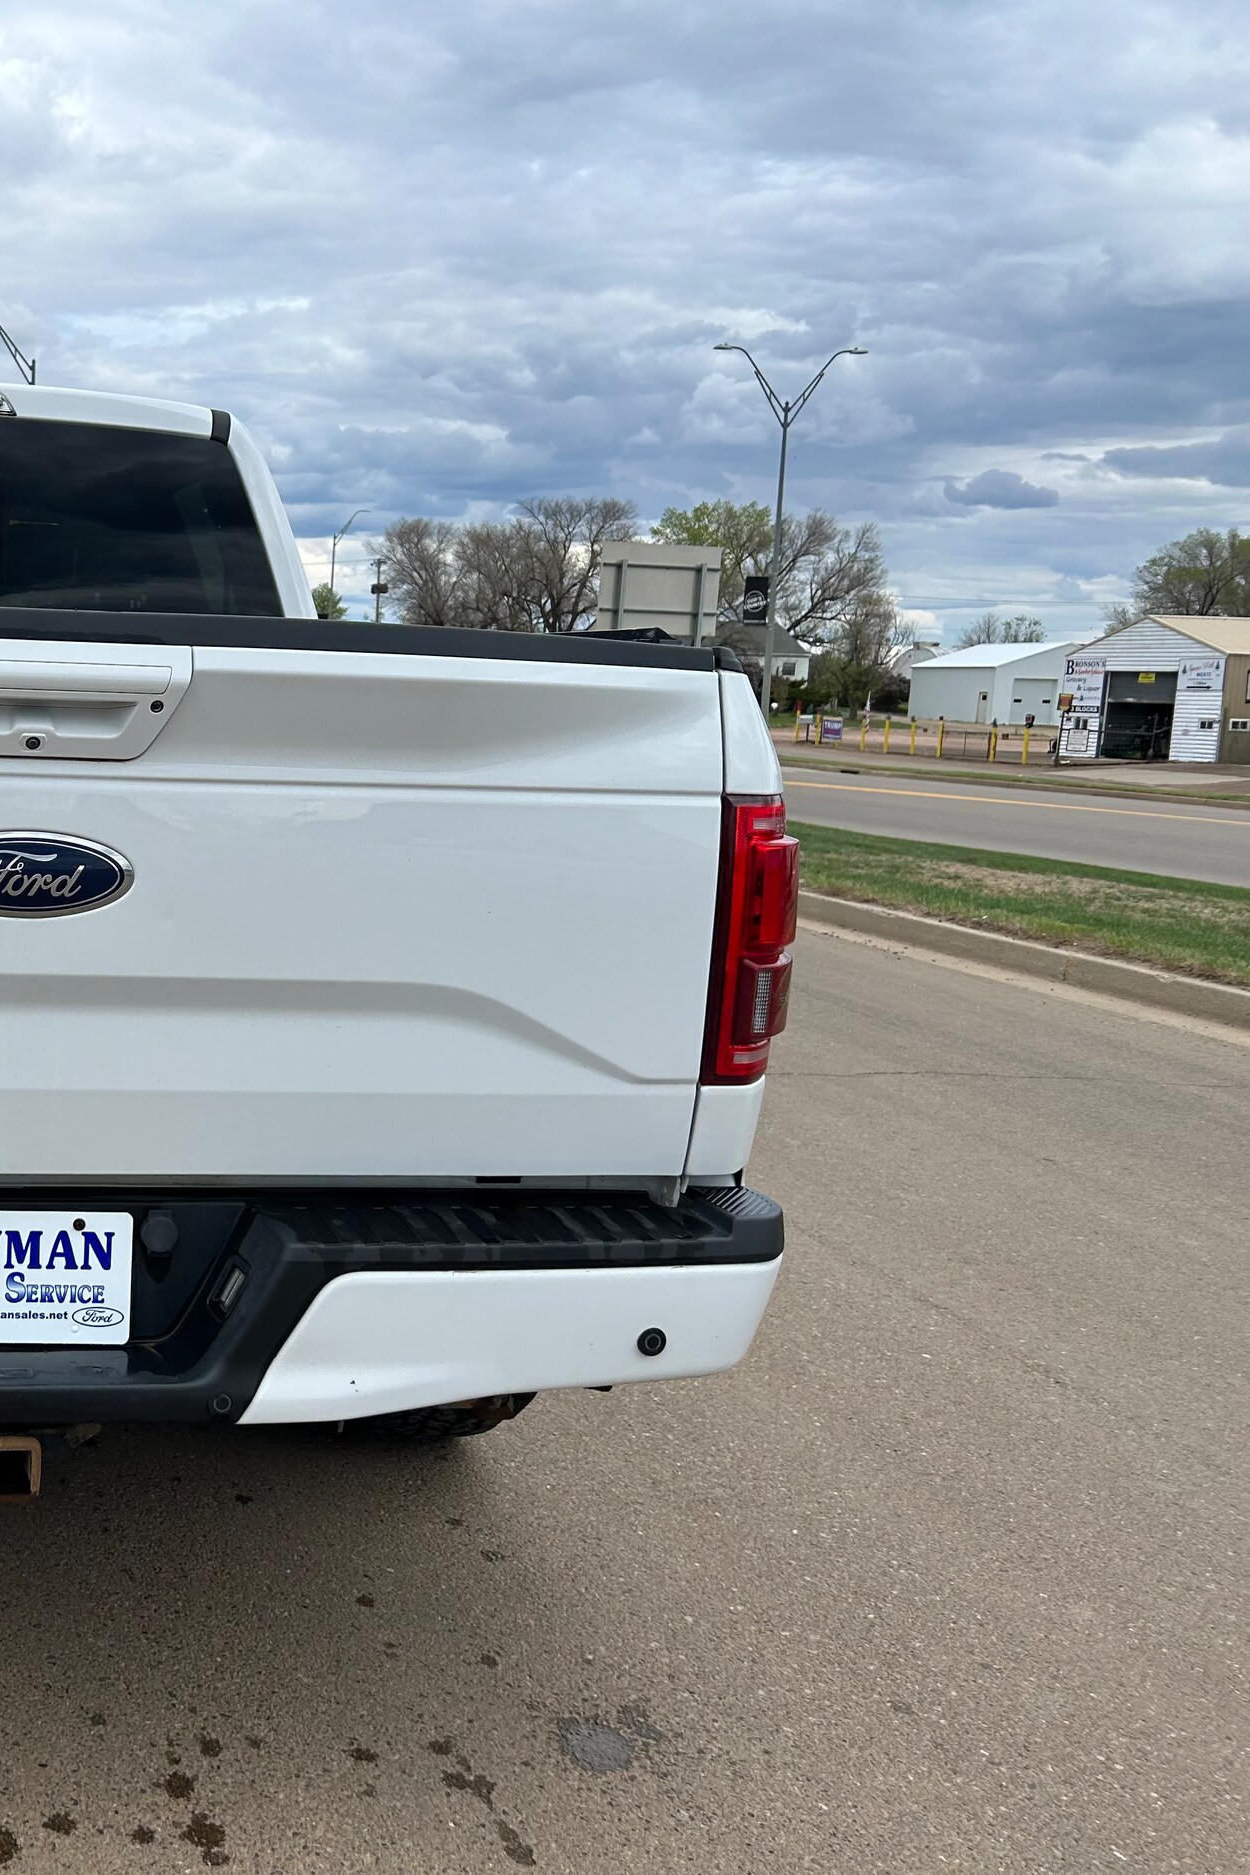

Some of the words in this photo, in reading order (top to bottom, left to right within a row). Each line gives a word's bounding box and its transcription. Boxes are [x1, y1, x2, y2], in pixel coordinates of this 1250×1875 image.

[1066, 660, 1106, 675] BRONSON'S
[1066, 676, 1086, 684] Grocery
[81, 1308, 117, 1323] Ford
